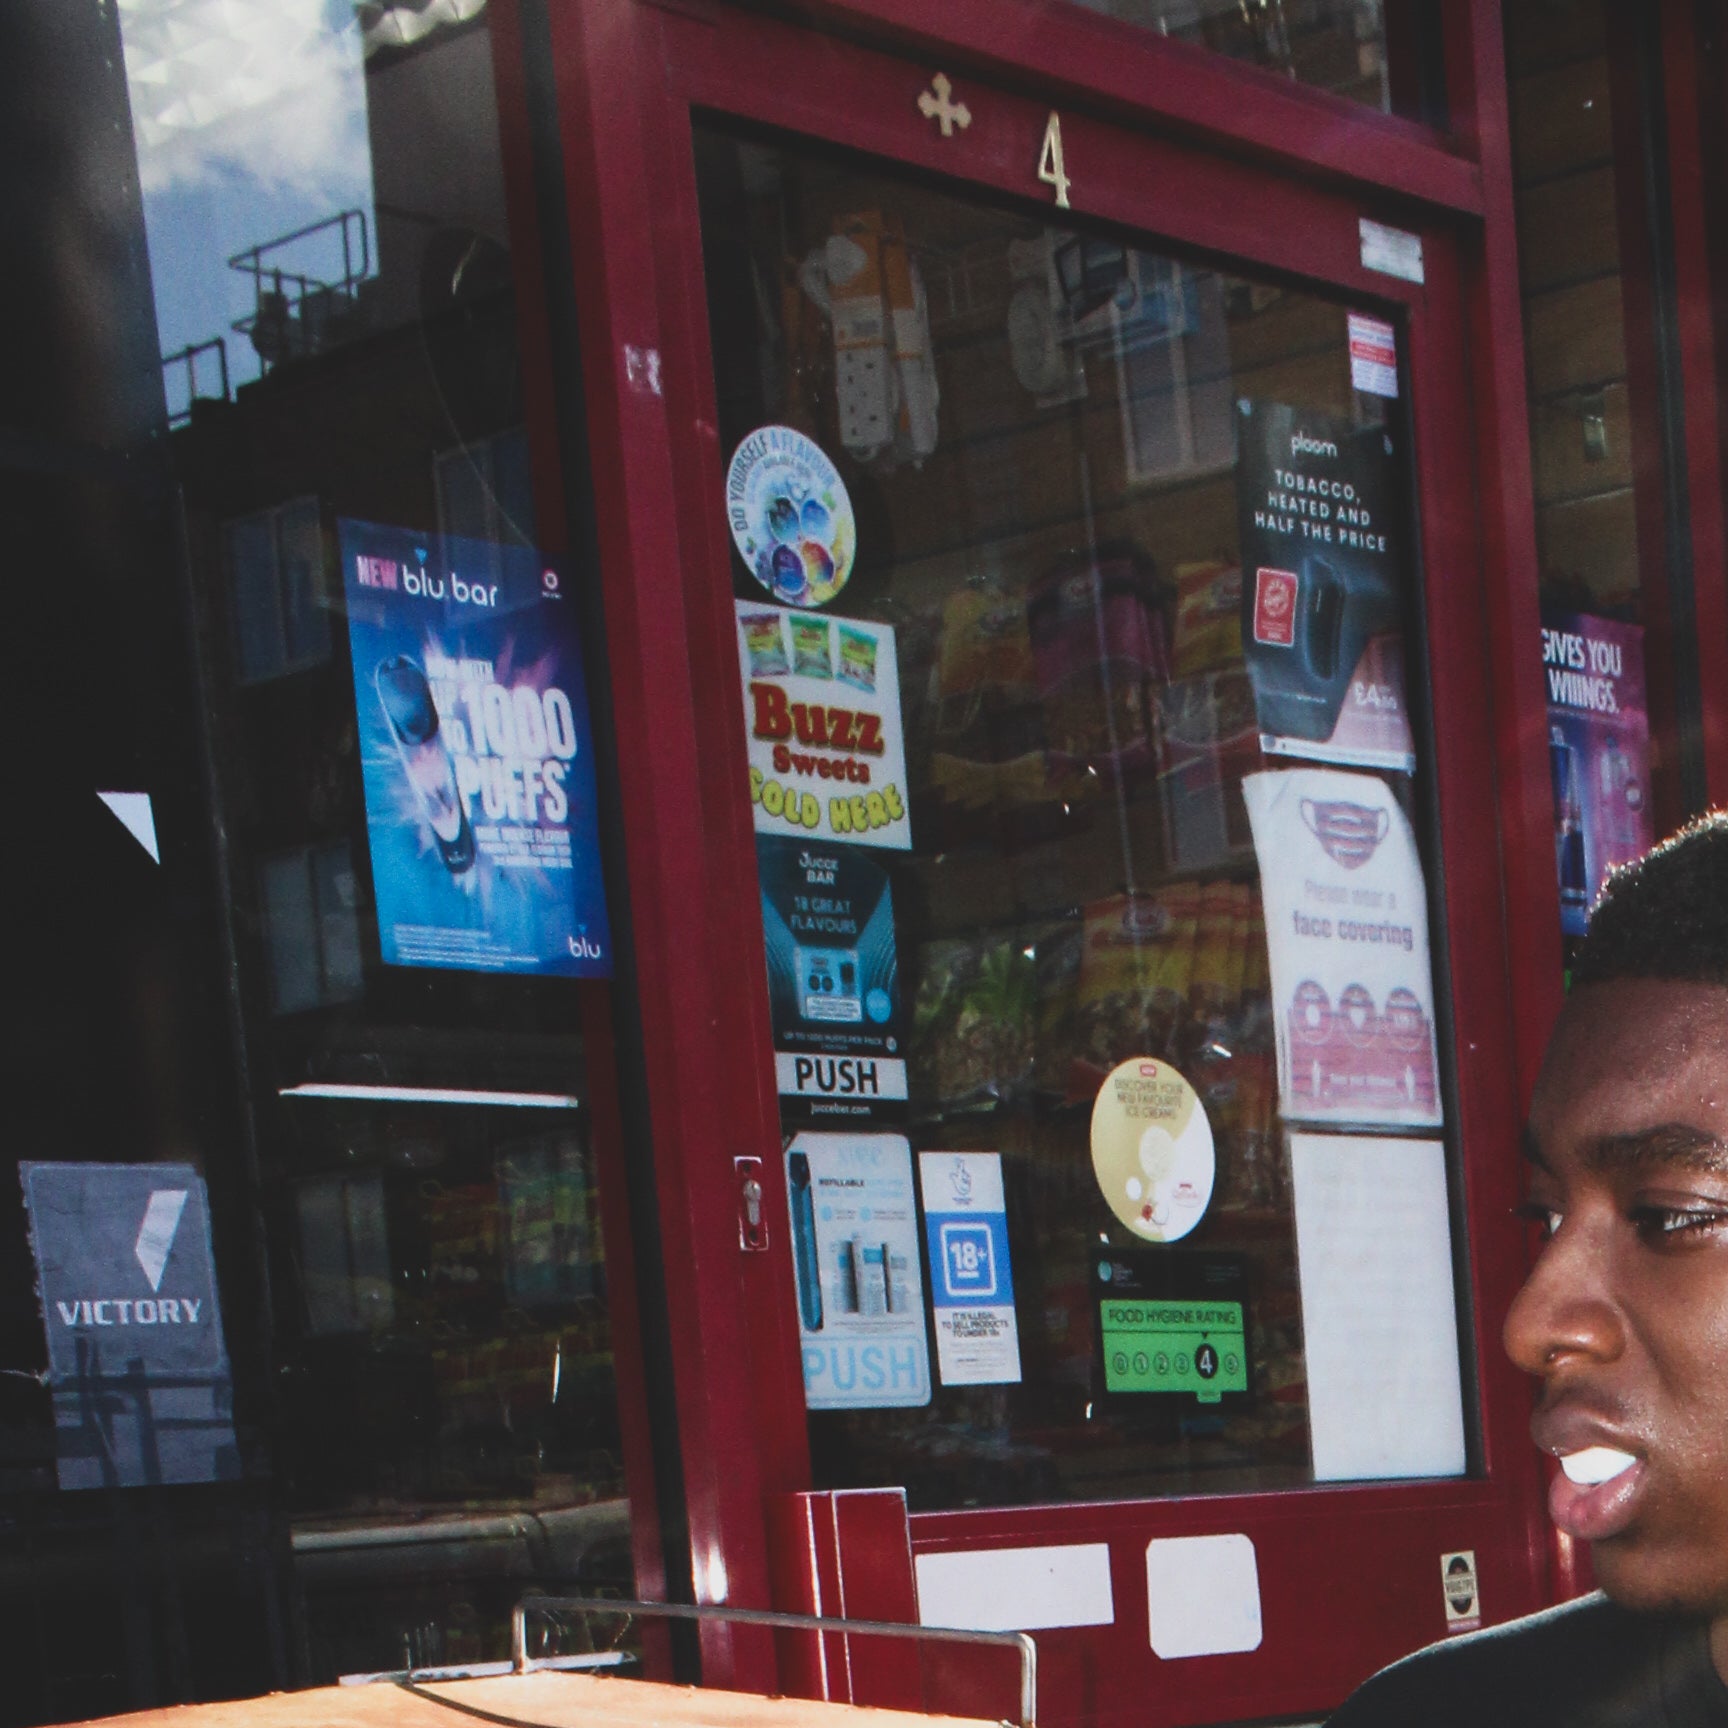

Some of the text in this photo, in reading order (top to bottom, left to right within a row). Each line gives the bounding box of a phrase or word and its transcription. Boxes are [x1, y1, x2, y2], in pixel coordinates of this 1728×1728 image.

[1037, 109, 1071, 209] 4
[1290, 431, 1338, 459] ploom
[730, 432, 769, 502] YOURSELF
[1274, 468, 1362, 505] TOBACCO,
[1267, 489, 1371, 527] HEATED AND
[1254, 509, 1388, 553] HALF THE PRICE
[356, 555, 498, 608] NEW blu bar
[1587, 637, 1623, 677] YOU
[461, 682, 578, 761] 1000
[750, 681, 885, 757] Buzz
[750, 766, 905, 834] SOLD HERE
[806, 869, 836, 887] BAR
[568, 937, 601, 960] blu
[1336, 918, 1414, 952] covering
[794, 1056, 880, 1095] PUSH
[57, 1298, 201, 1327] VICTORY
[1109, 1309, 1144, 1325] FOOD
[1146, 1309, 1195, 1325] HYGIENE
[803, 1345, 917, 1391] PUSH
[1199, 1349, 1214, 1375] 4
